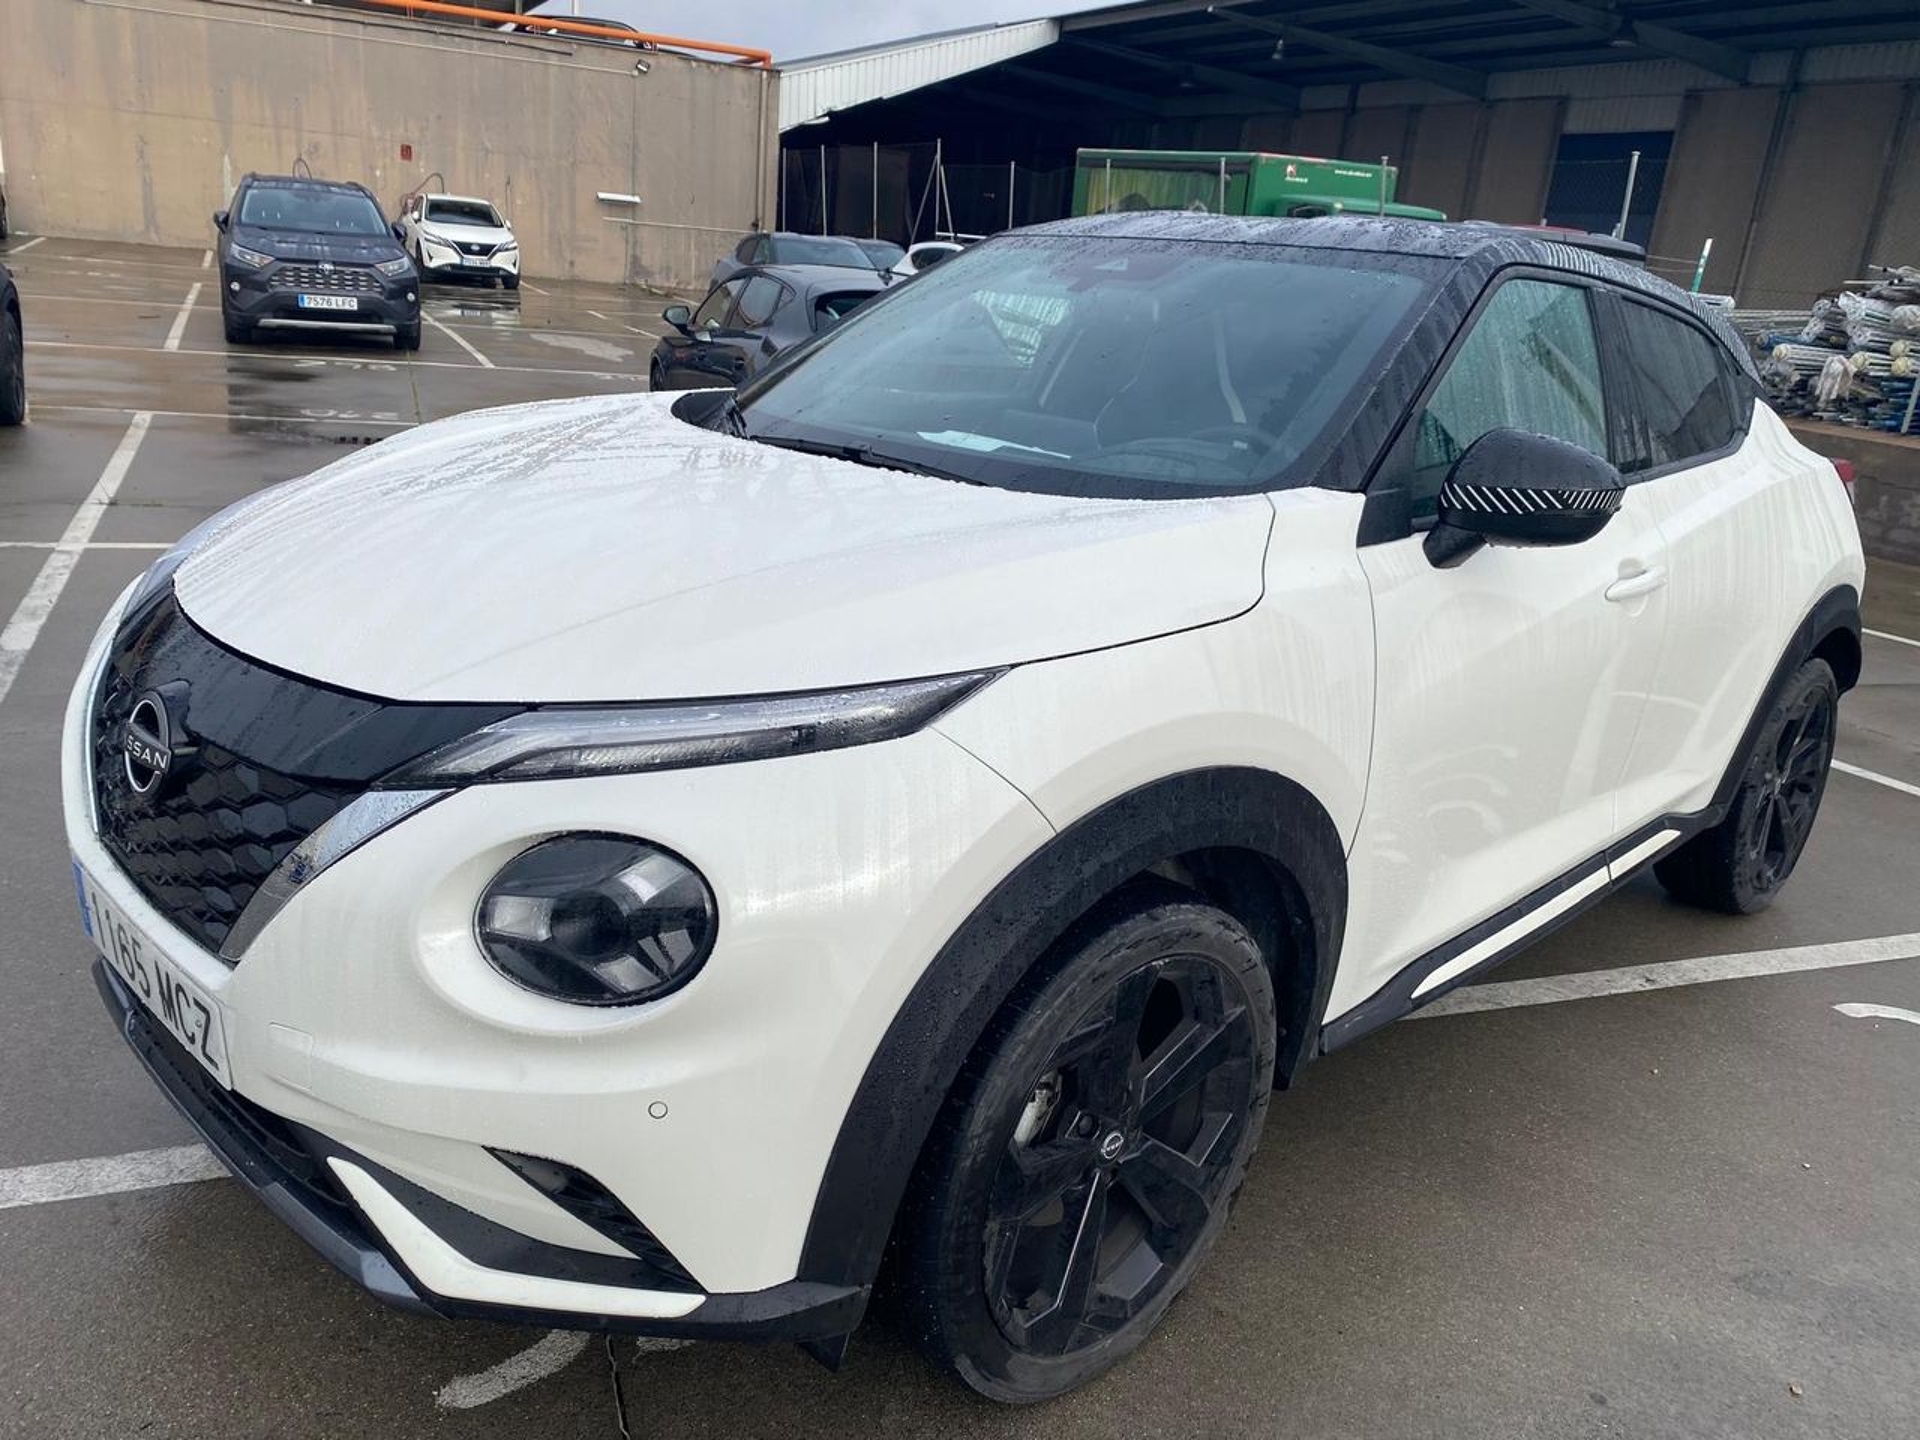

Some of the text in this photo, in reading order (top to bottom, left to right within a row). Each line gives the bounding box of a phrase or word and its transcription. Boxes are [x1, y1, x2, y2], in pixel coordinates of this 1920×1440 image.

[305, 296, 355, 308] 7576 LFC
[91, 891, 219, 1071] 1165 MCZ
